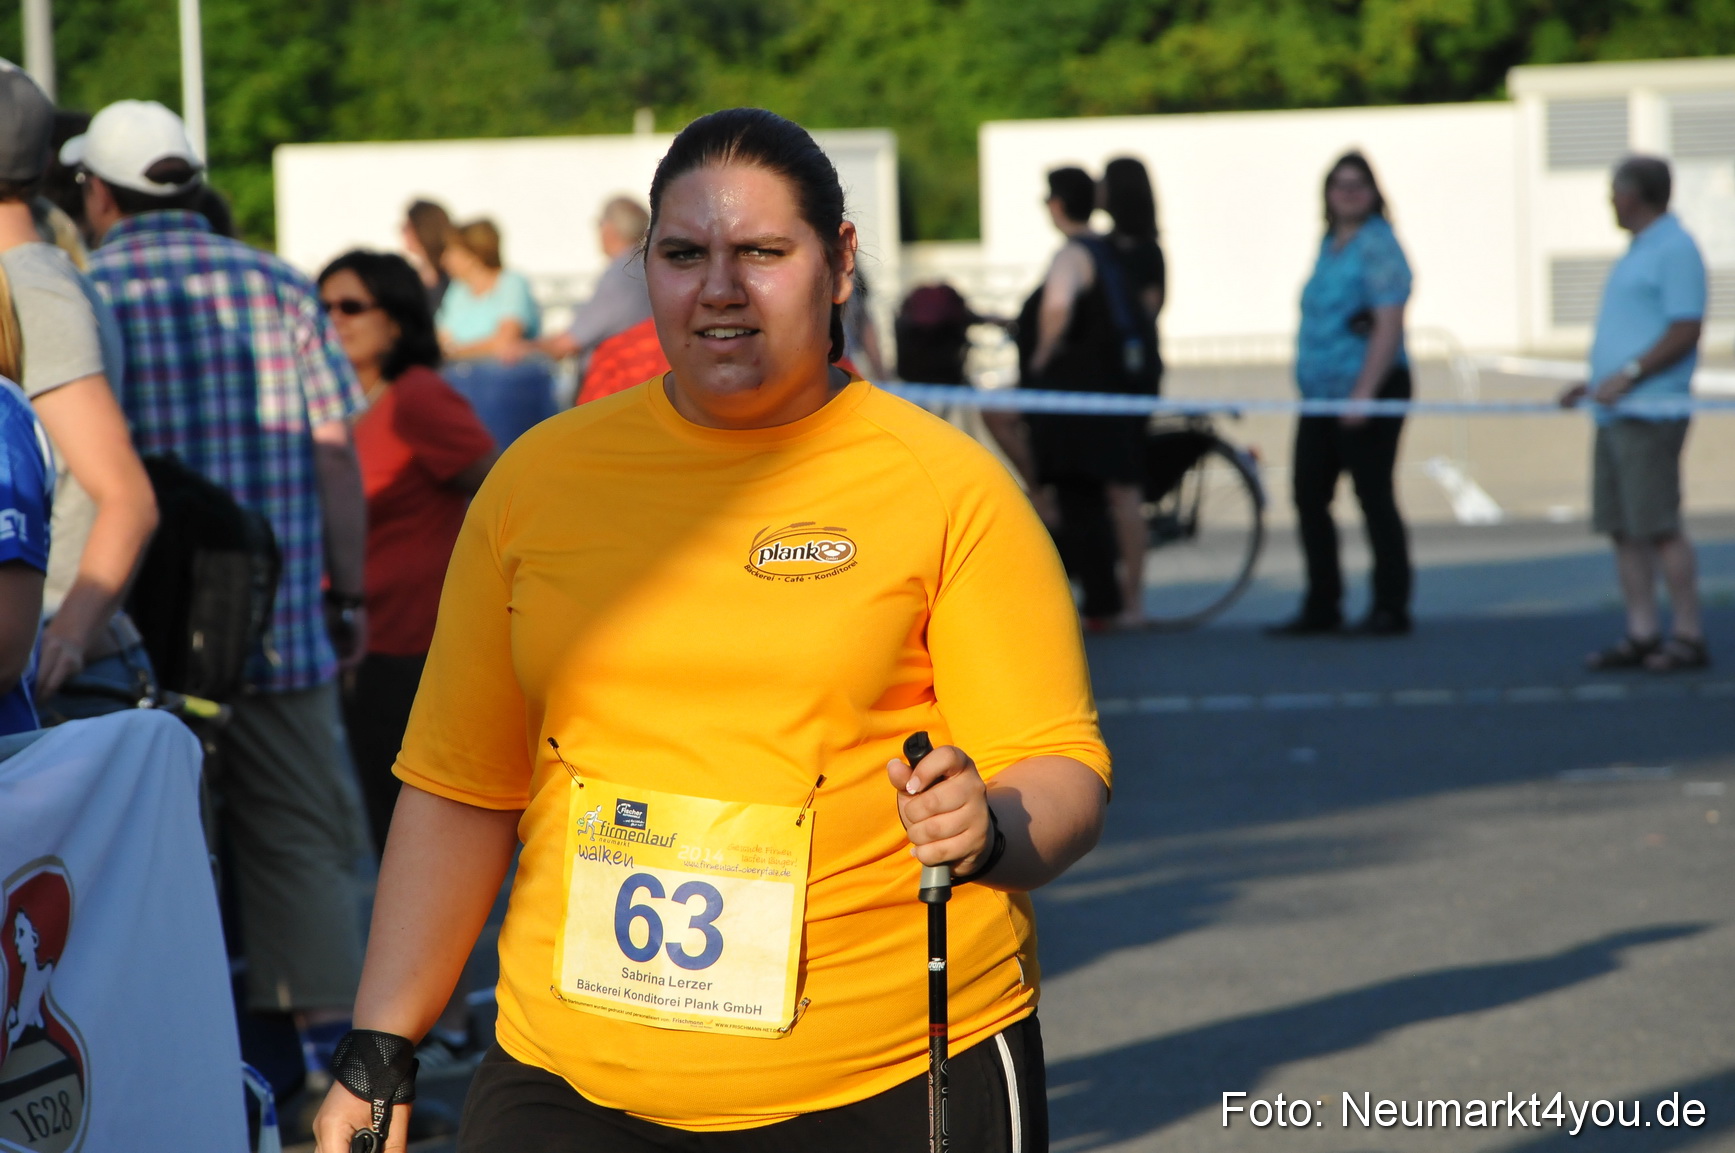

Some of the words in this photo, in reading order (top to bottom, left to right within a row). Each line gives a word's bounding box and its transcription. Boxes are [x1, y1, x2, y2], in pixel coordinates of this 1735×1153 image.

[758, 541, 822, 565] plank
[744, 564, 774, 582] Bäckerei
[784, 575, 804, 583] Café
[814, 560, 858, 581] Konditorei
[599, 837, 630, 847] neumarkt
[600, 822, 677, 848] firmenlauf
[578, 844, 634, 869] walken
[678, 845, 724, 864] 2014
[765, 846, 792, 856] Firmen
[614, 872, 724, 971] 63
[621, 967, 665, 987] Sabrina
[669, 975, 713, 991] Lerzer
[577, 979, 621, 998] Bäckerei
[623, 988, 681, 1008] Konditorei
[684, 997, 719, 1011] Plank
[723, 1001, 762, 1016] GmbH
[672, 1017, 704, 1026] Frischmann
[10, 1090, 72, 1143] 1628
